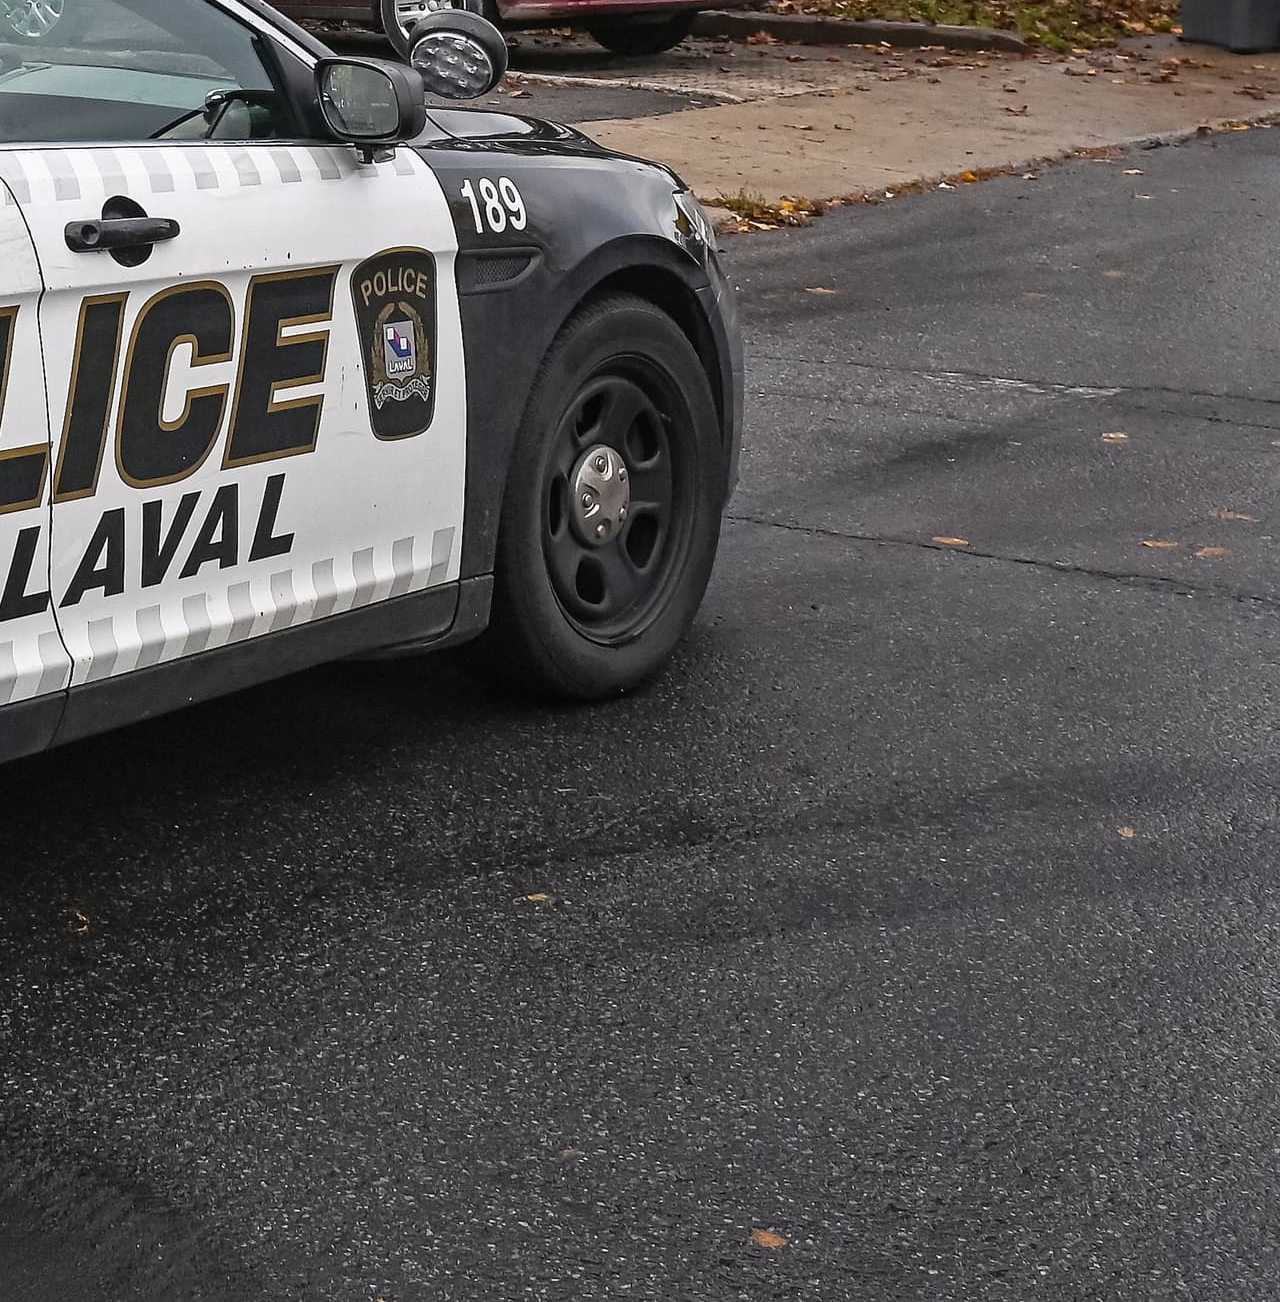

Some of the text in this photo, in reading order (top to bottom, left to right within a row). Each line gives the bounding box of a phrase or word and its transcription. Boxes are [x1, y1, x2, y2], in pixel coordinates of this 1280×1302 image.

[460, 177, 527, 234] 189
[360, 267, 428, 307] POLICE
[389, 358, 414, 373] LAVAL
